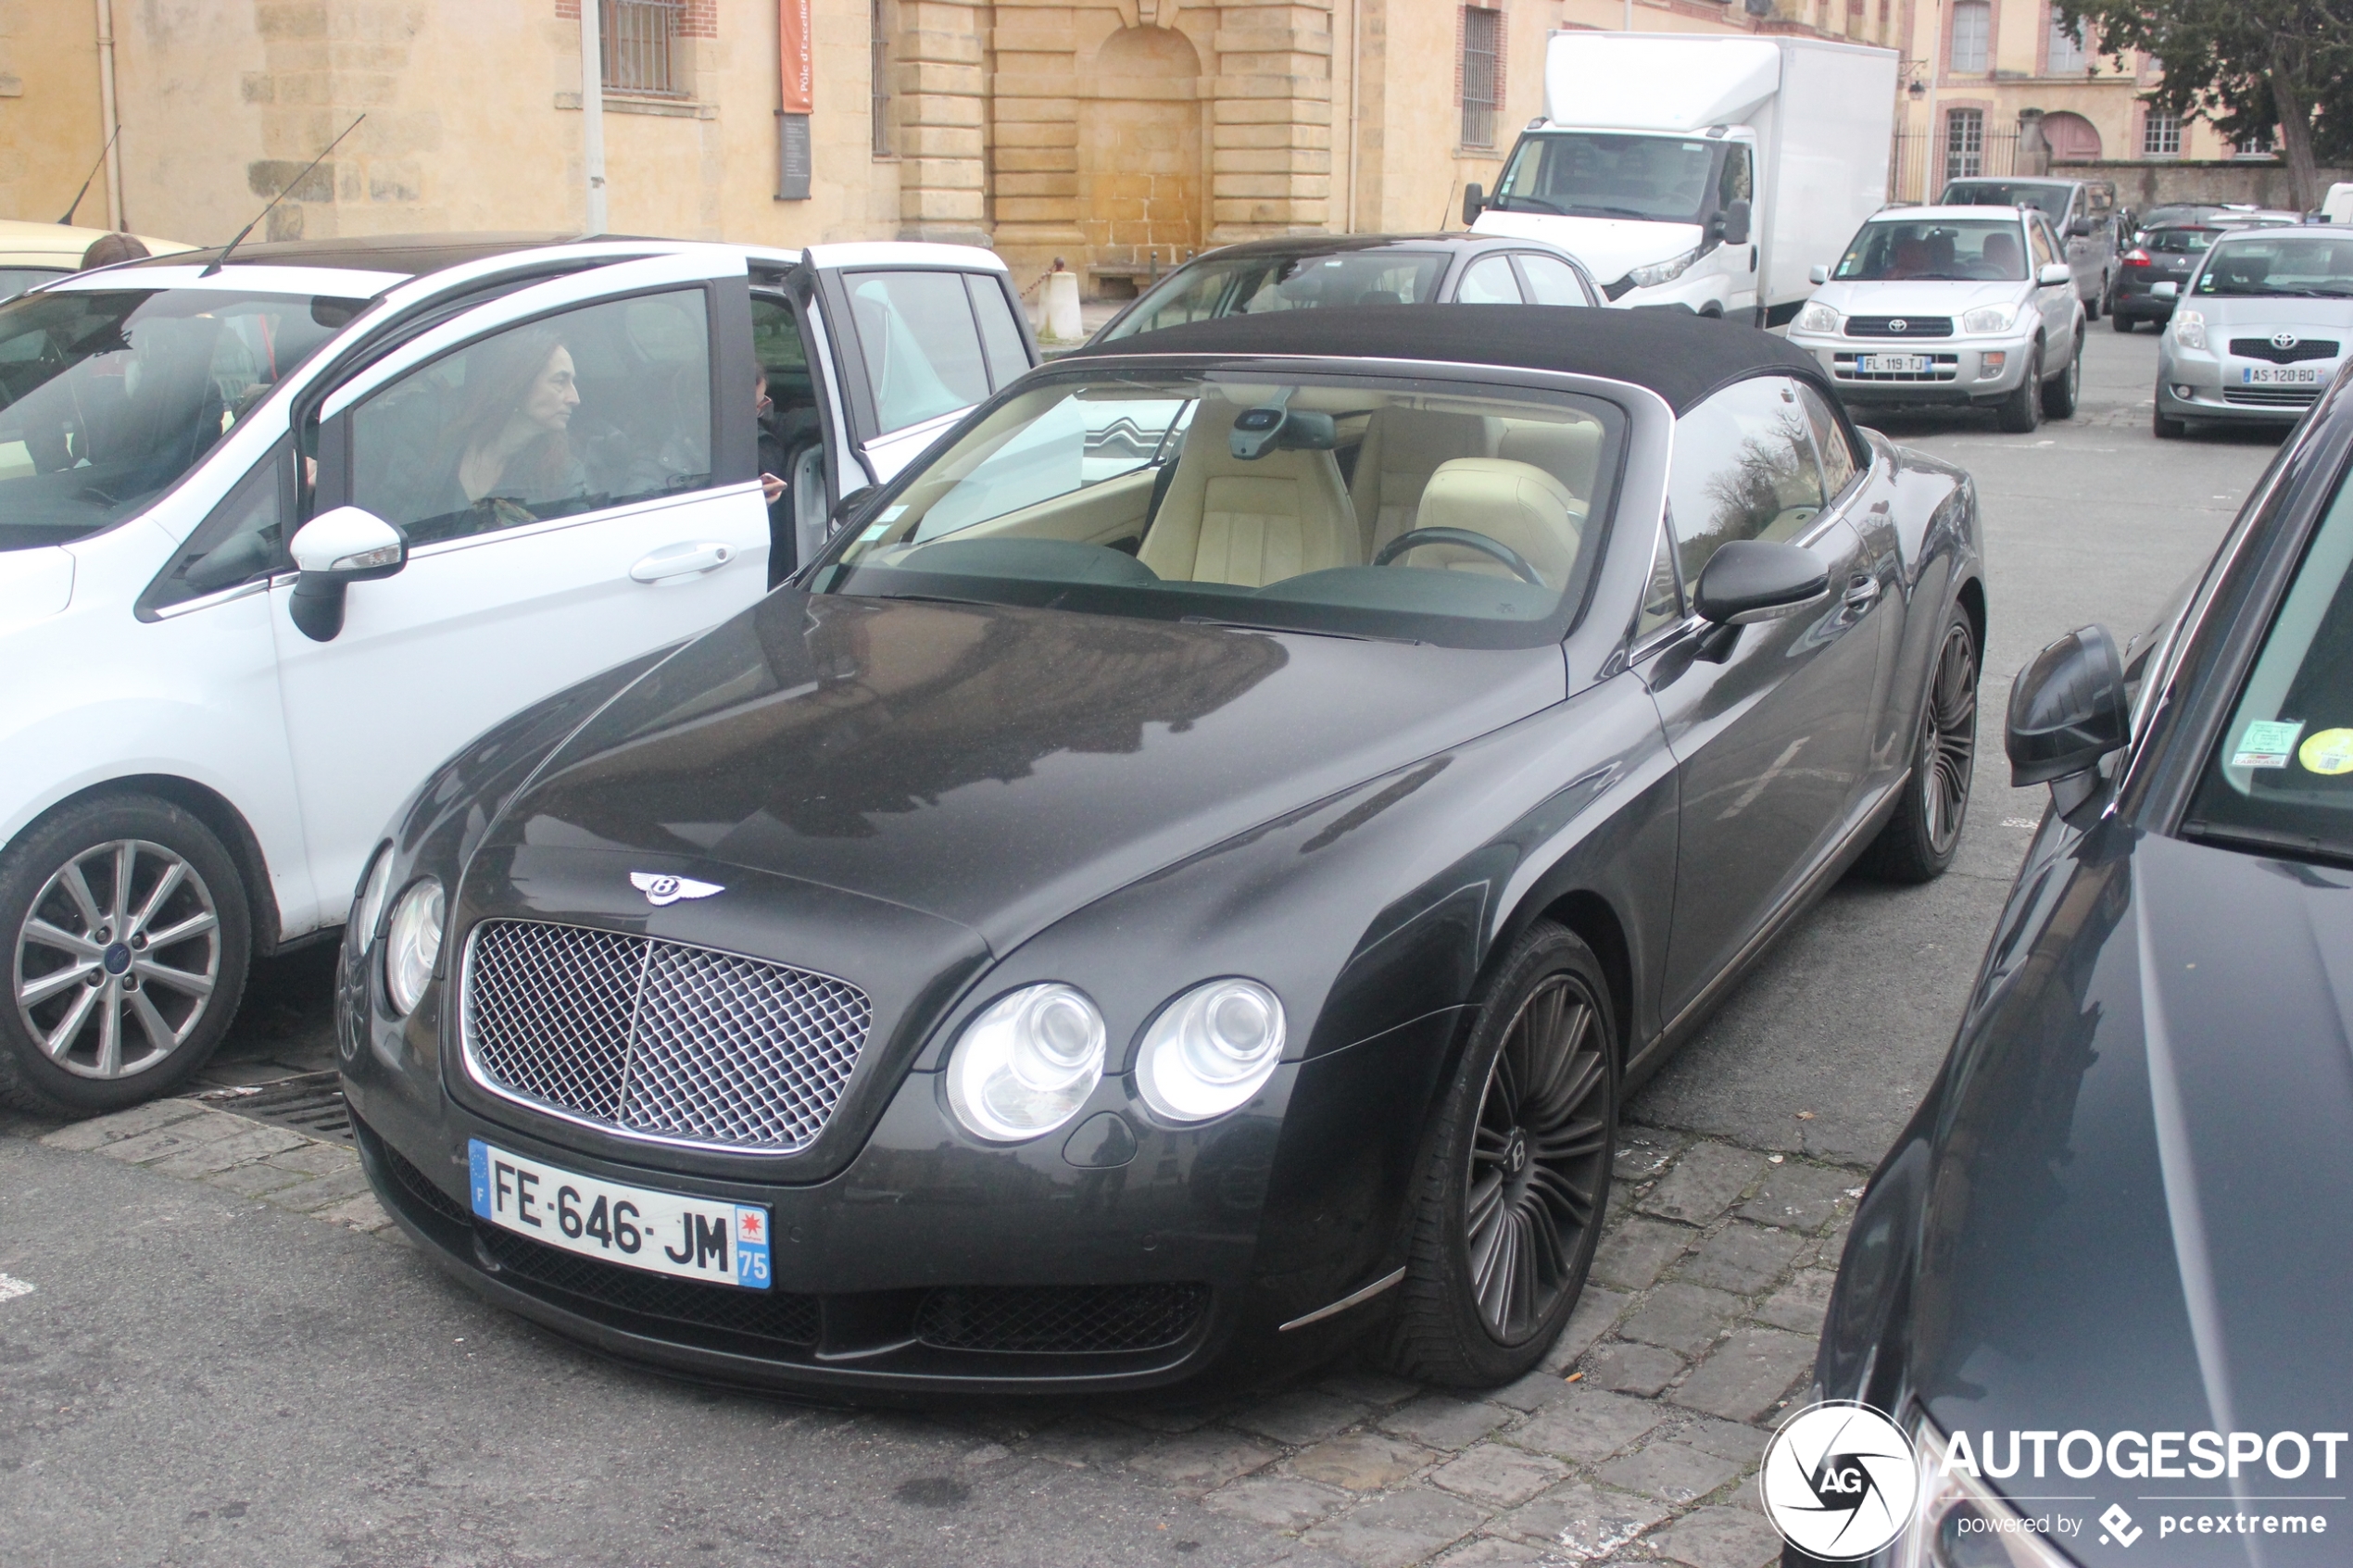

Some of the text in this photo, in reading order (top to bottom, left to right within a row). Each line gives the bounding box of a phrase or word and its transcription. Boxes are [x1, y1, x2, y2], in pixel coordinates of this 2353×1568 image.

[799, 65, 809, 92] Pôle
[477, 1186, 484, 1202] F
[738, 1250, 768, 1280] 75
